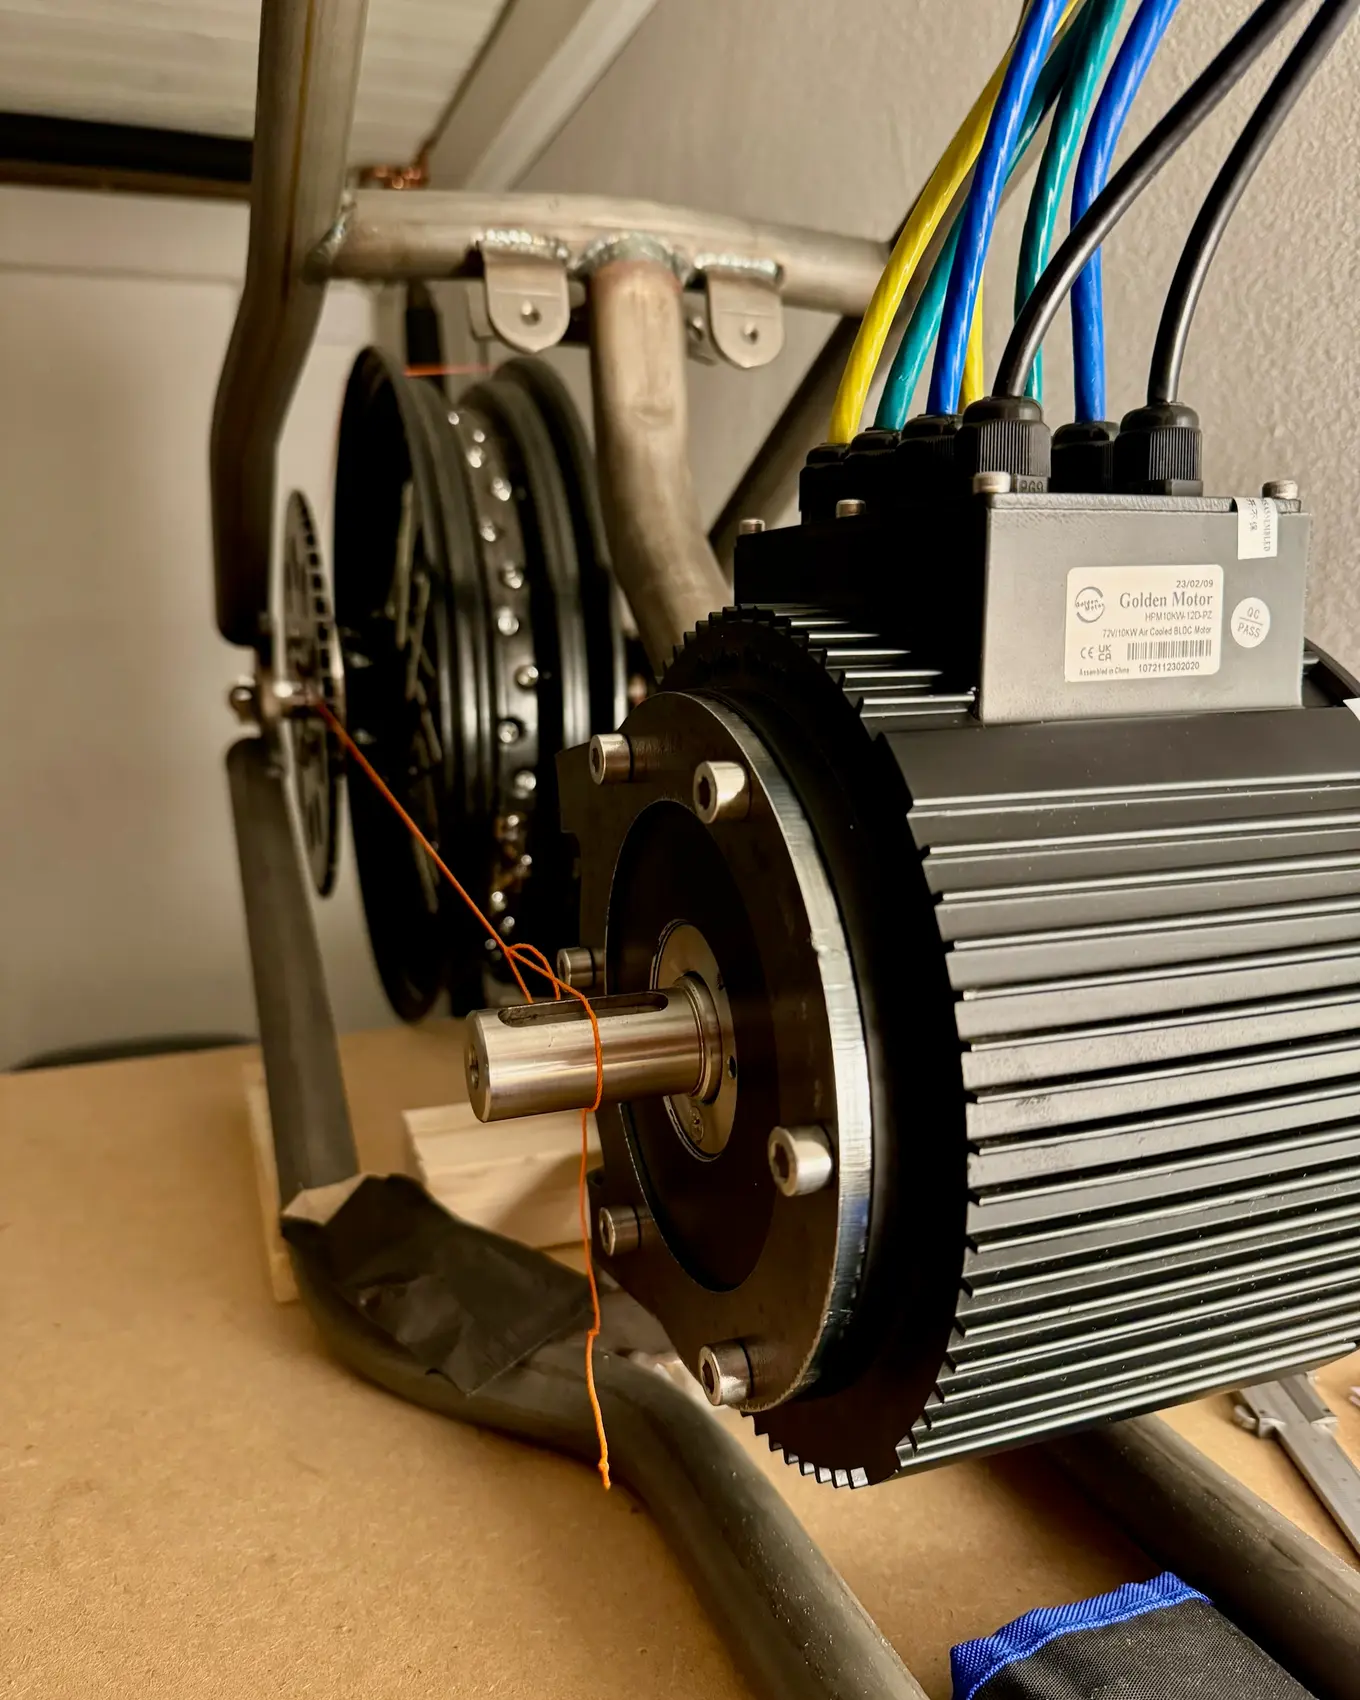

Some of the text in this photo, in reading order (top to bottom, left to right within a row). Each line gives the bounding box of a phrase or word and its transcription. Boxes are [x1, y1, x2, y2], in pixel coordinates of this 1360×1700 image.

[1176, 580, 1214, 589] 23/02/09
[1120, 591, 1213, 608] Golden Motor
[1145, 610, 1213, 622] HPM10KW-12D-PZ
[1246, 606, 1260, 619] QC
[1102, 625, 1212, 638] 72V/10KW Air Cooled BLDC Motor
[1237, 622, 1261, 638] PASS
[1079, 668, 1108, 677] Assembled
[1115, 666, 1130, 675] China
[1138, 662, 1200, 673] 1072112302020
